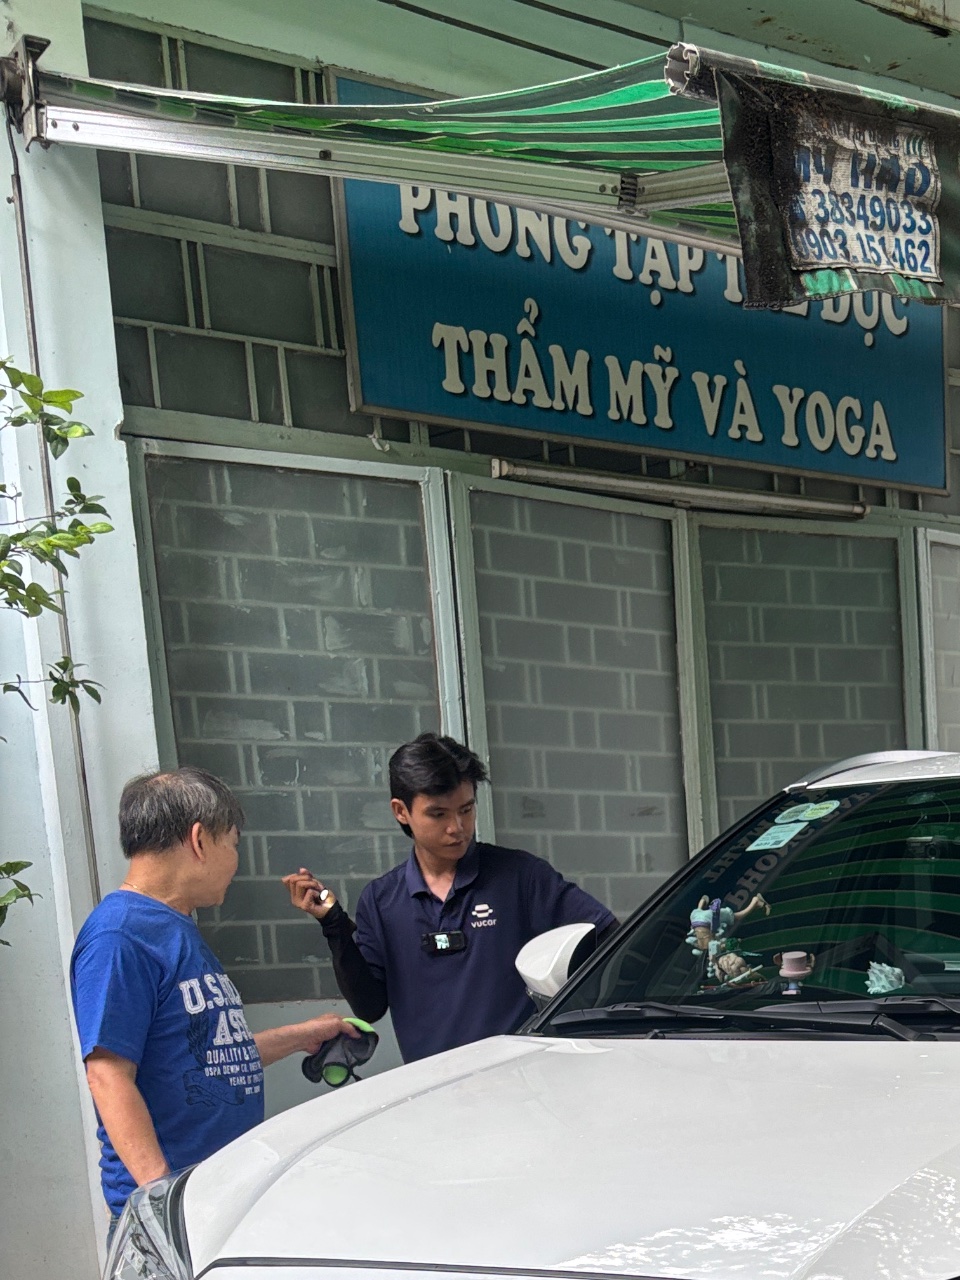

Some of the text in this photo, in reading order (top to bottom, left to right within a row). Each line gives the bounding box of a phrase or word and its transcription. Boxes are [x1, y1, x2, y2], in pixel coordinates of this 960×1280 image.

[812, 188, 932, 236] 38349033
[431, 297, 898, 462] THẨM MỸ VÀ YOGA
[471, 918, 497, 928] vucar
